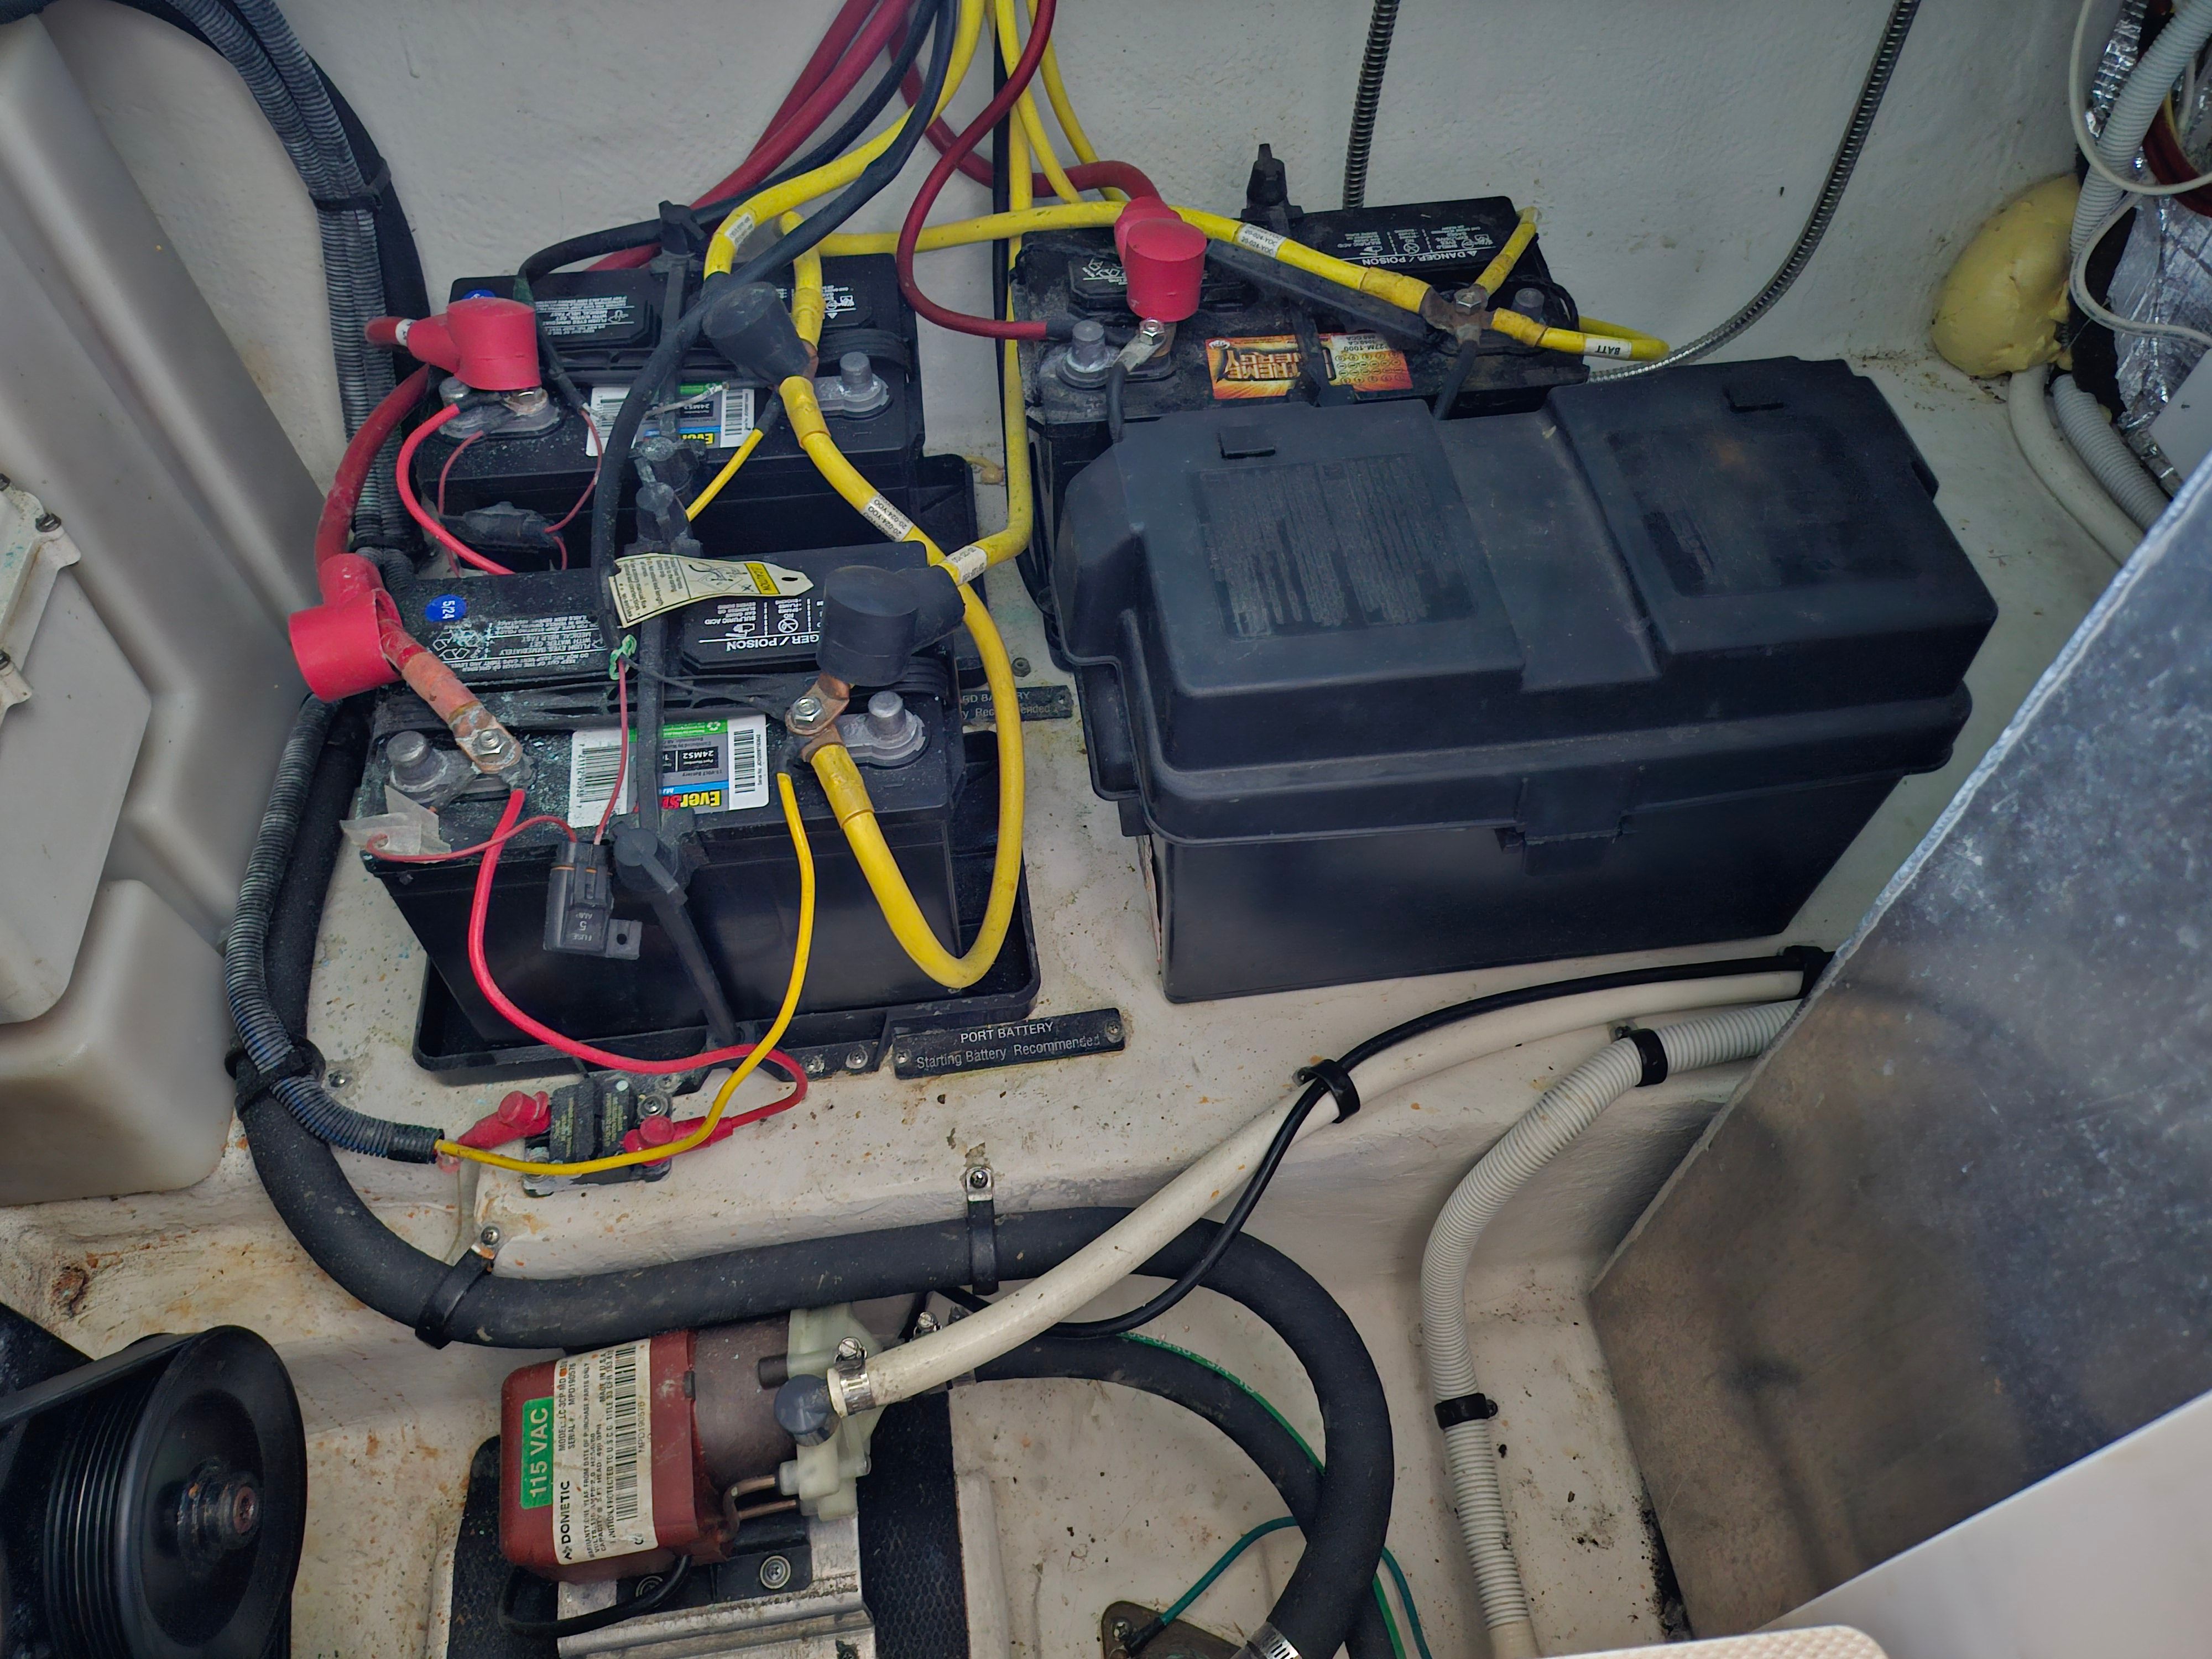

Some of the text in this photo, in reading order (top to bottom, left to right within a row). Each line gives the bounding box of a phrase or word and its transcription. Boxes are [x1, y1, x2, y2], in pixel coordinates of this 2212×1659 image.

[1362, 256, 1406, 265] POISON
[1417, 252, 1466, 262] DANGER
[1595, 345, 1620, 355] BATT
[754, 571, 772, 591] CAUTION
[440, 600, 456, 619] 5/24
[791, 634, 820, 644] GER
[726, 637, 778, 652] POISON
[499, 647, 546, 656] IMMEDIATELY
[683, 750, 714, 759] 24MS2
[579, 920, 588, 931] 5
[572, 933, 593, 941] FUSE
[960, 1021, 1054, 1044] PORT BATTERY
[916, 1033, 1100, 1070] Starting Battery Recommended
[567, 1363, 576, 1405] MPD190576
[606, 1390, 613, 1399] 33
[584, 1439, 589, 1447] OF
[529, 1407, 548, 1498] 115 VAC
[607, 1454, 613, 1464] TO
[560, 1480, 571, 1545] DOMETIC
[597, 1515, 607, 1551] CAPACITY
